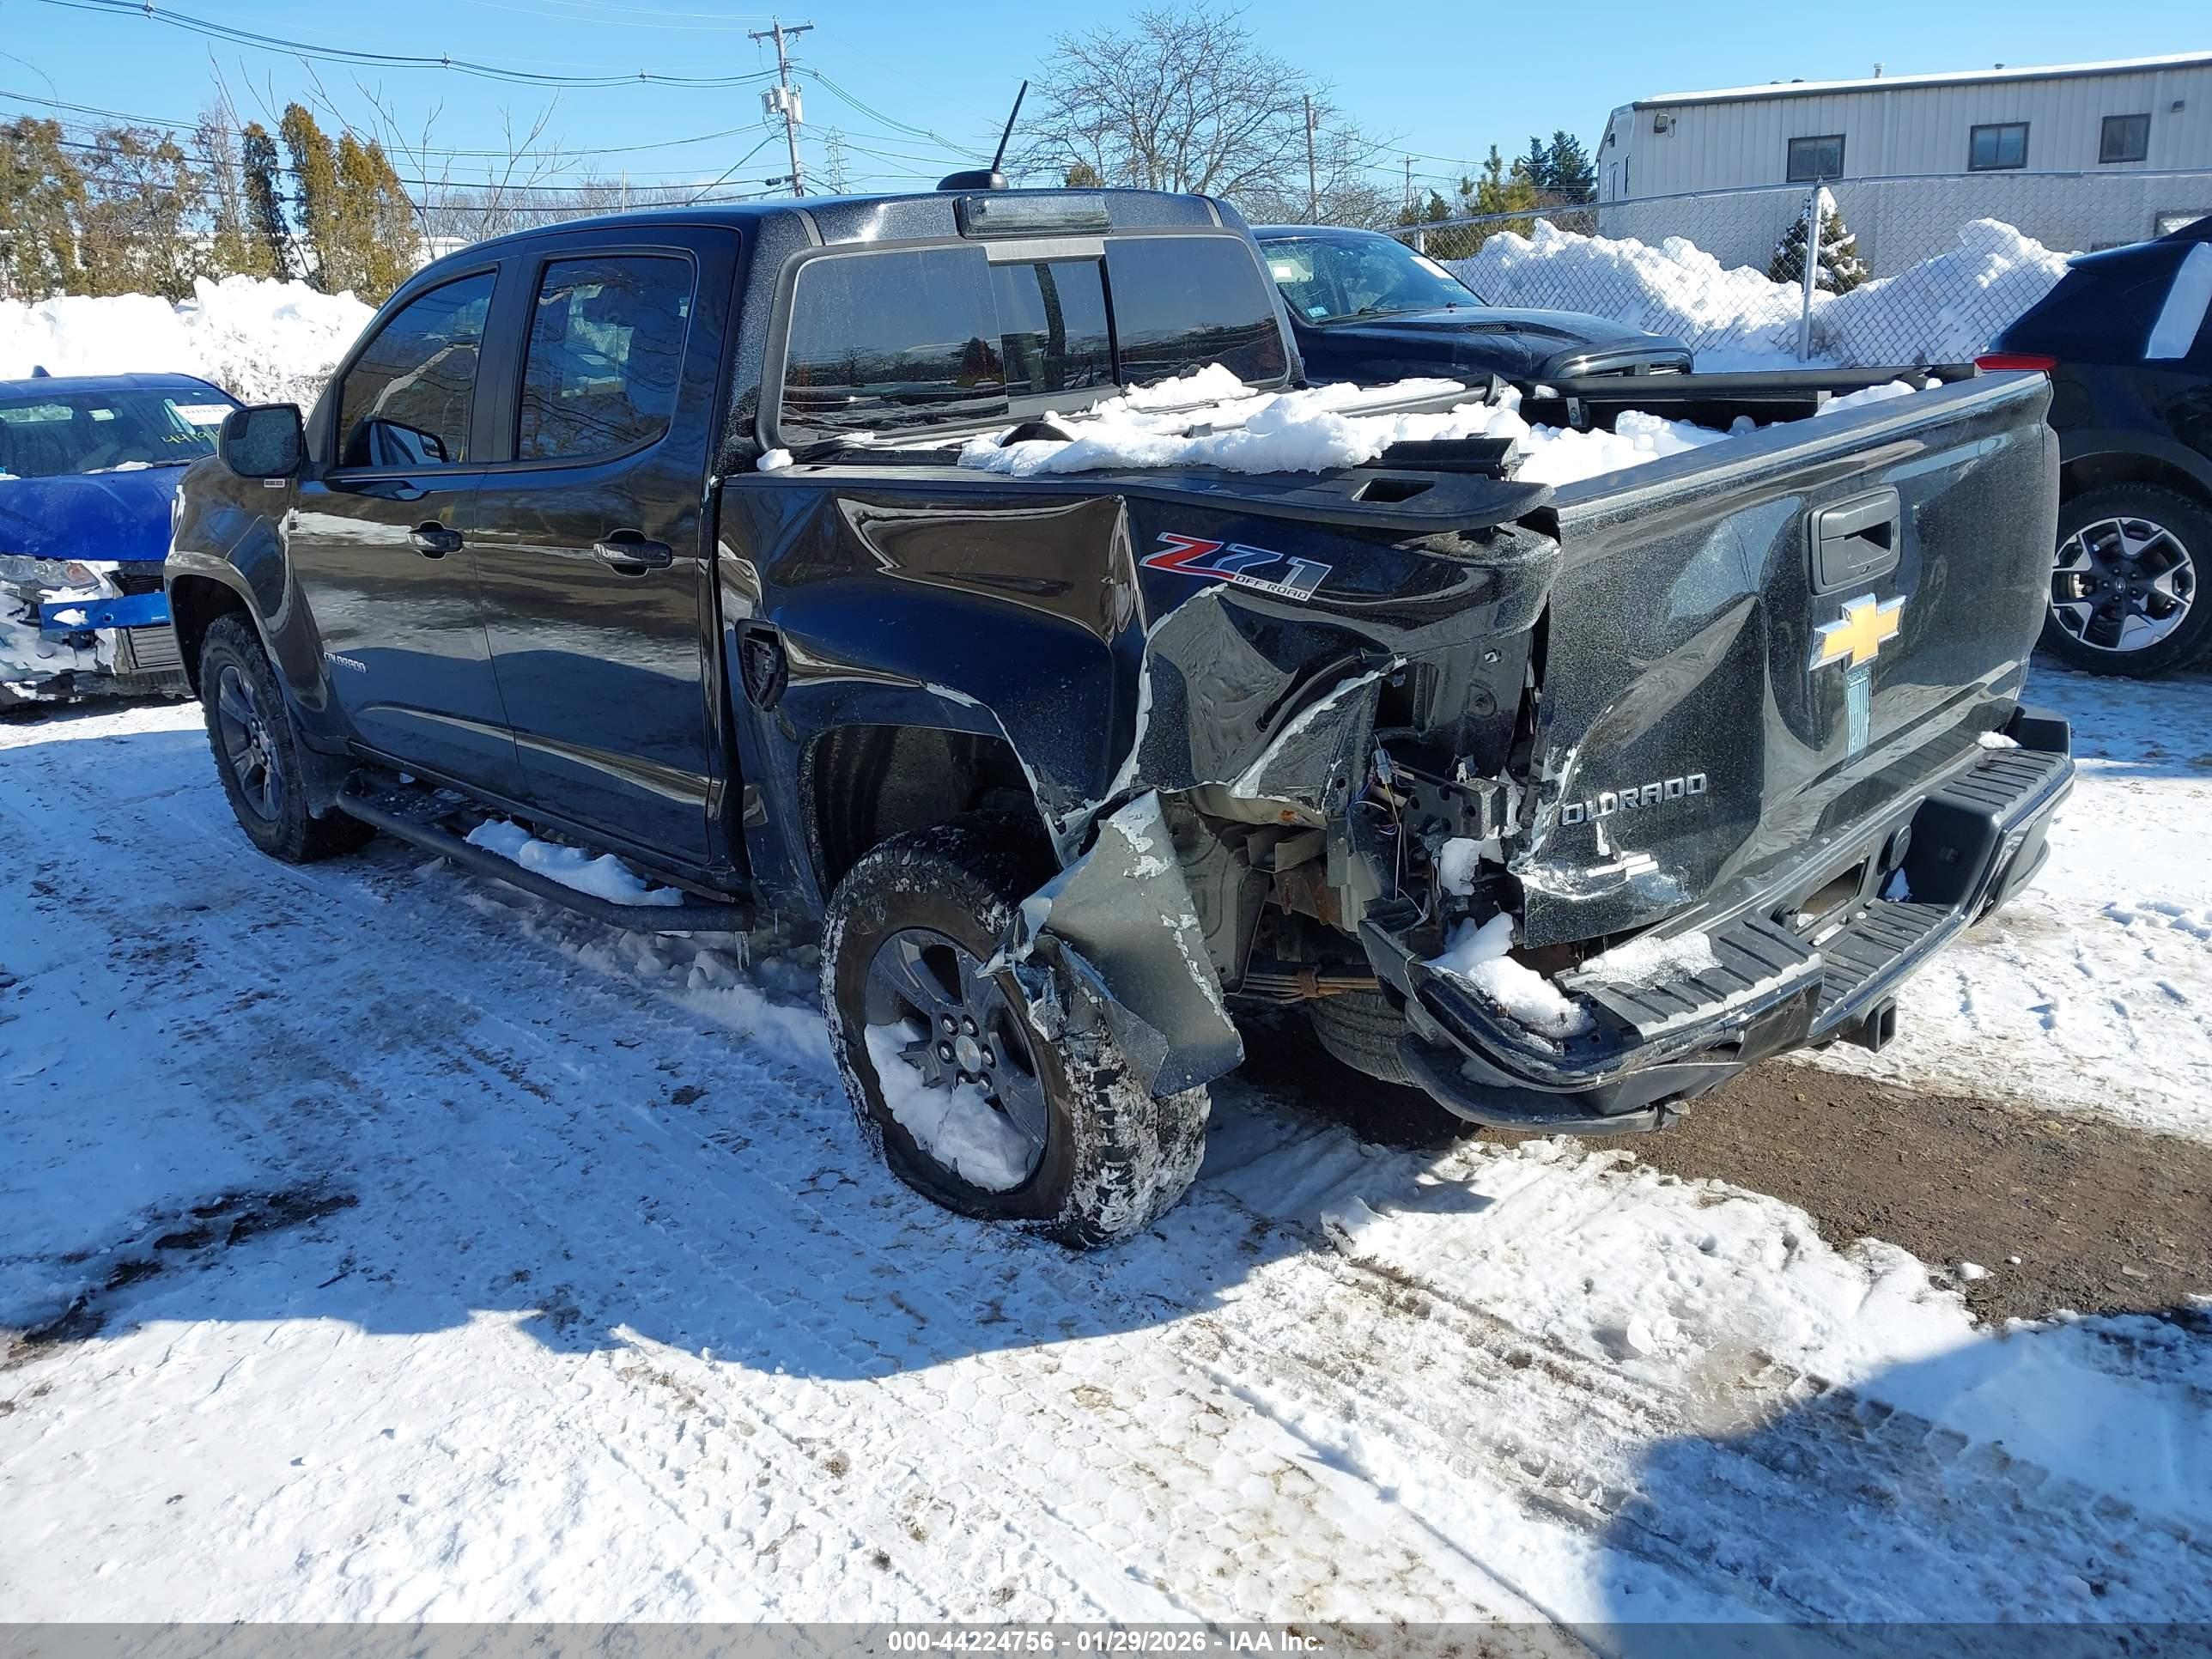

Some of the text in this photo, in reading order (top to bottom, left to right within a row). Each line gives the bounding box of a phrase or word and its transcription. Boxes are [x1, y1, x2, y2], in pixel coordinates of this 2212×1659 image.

[1139, 532, 1333, 592] Z71
[1235, 574, 1310, 600] OFF ROAD
[1846, 666, 1870, 684] SURPLUS
